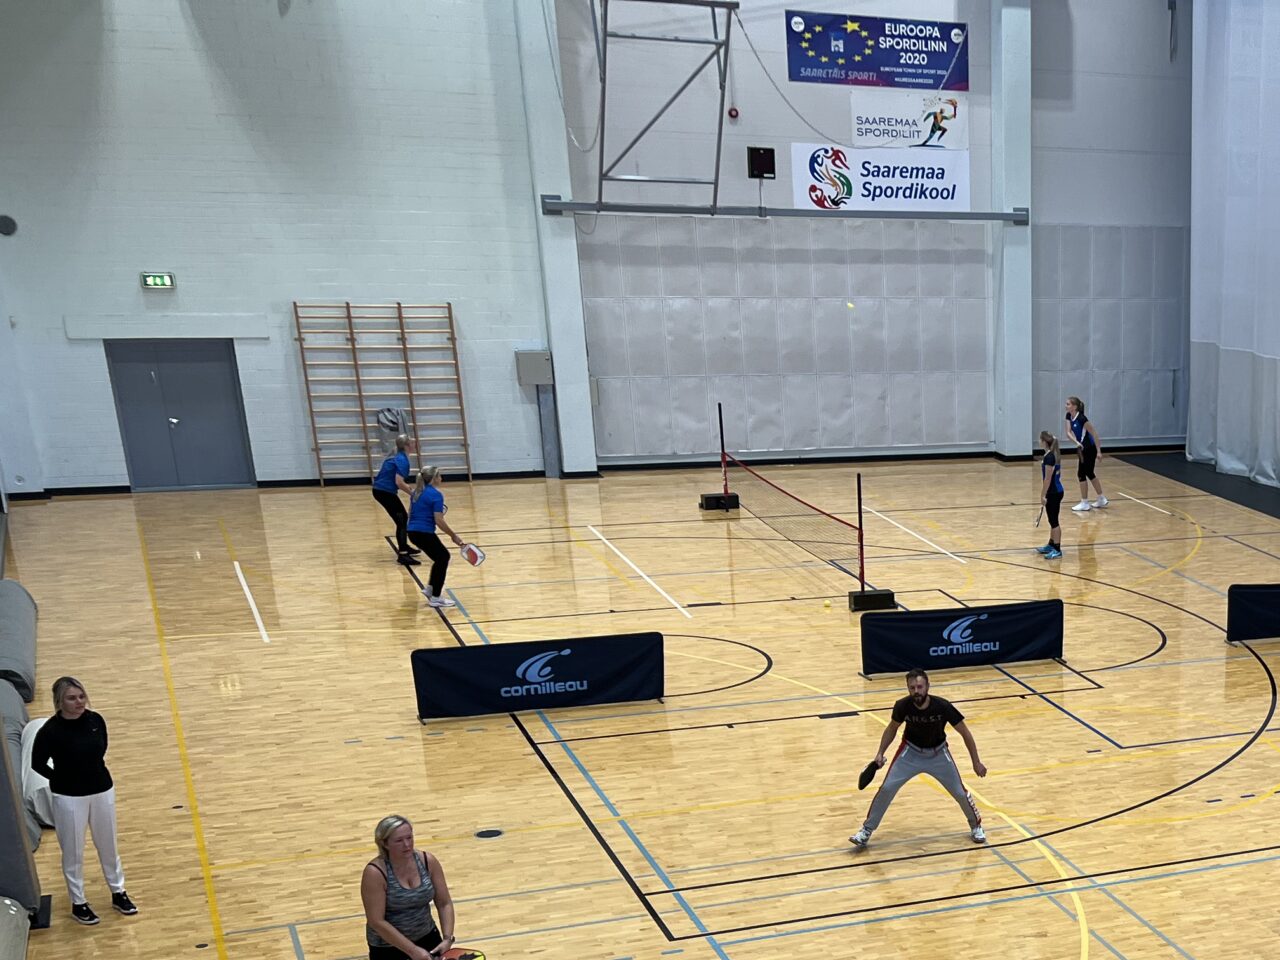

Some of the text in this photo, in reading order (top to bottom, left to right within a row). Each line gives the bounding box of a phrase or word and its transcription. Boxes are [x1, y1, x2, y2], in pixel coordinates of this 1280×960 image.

[885, 22, 941, 39] EUROOPA
[879, 37, 948, 53] SPORDILINN
[899, 52, 928, 65] 2020
[847, 70, 877, 81] SPORTI
[856, 116, 918, 128] SAAREMAA
[856, 127, 922, 139] SPORDILIIT
[860, 160, 946, 180] Saaremaa
[860, 182, 957, 201] Spordikool
[929, 641, 1000, 656] cornilleau
[500, 680, 588, 697] cornilleau
